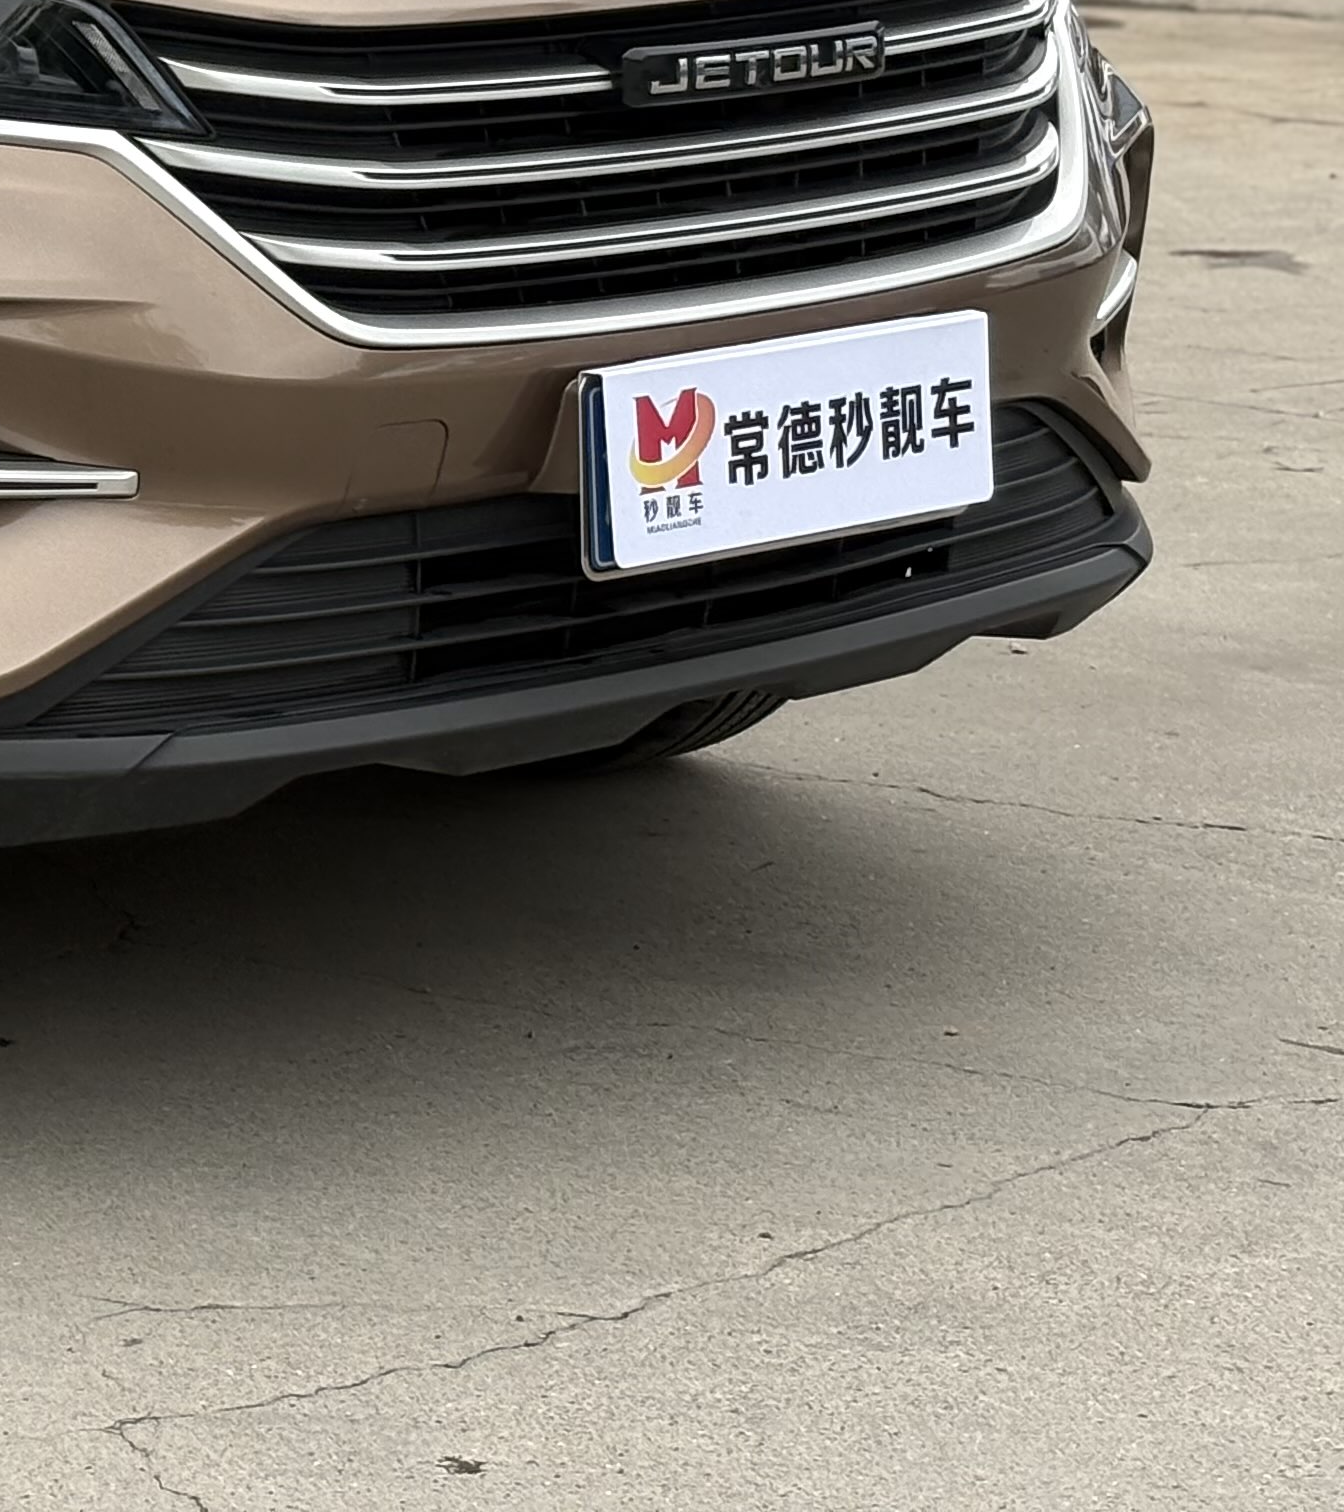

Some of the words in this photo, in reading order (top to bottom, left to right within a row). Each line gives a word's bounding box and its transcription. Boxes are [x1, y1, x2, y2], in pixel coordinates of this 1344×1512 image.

[650, 36, 878, 95] JETOUR
[724, 377, 975, 486] 常德秒靓车
[643, 492, 704, 524] 秒靓车
